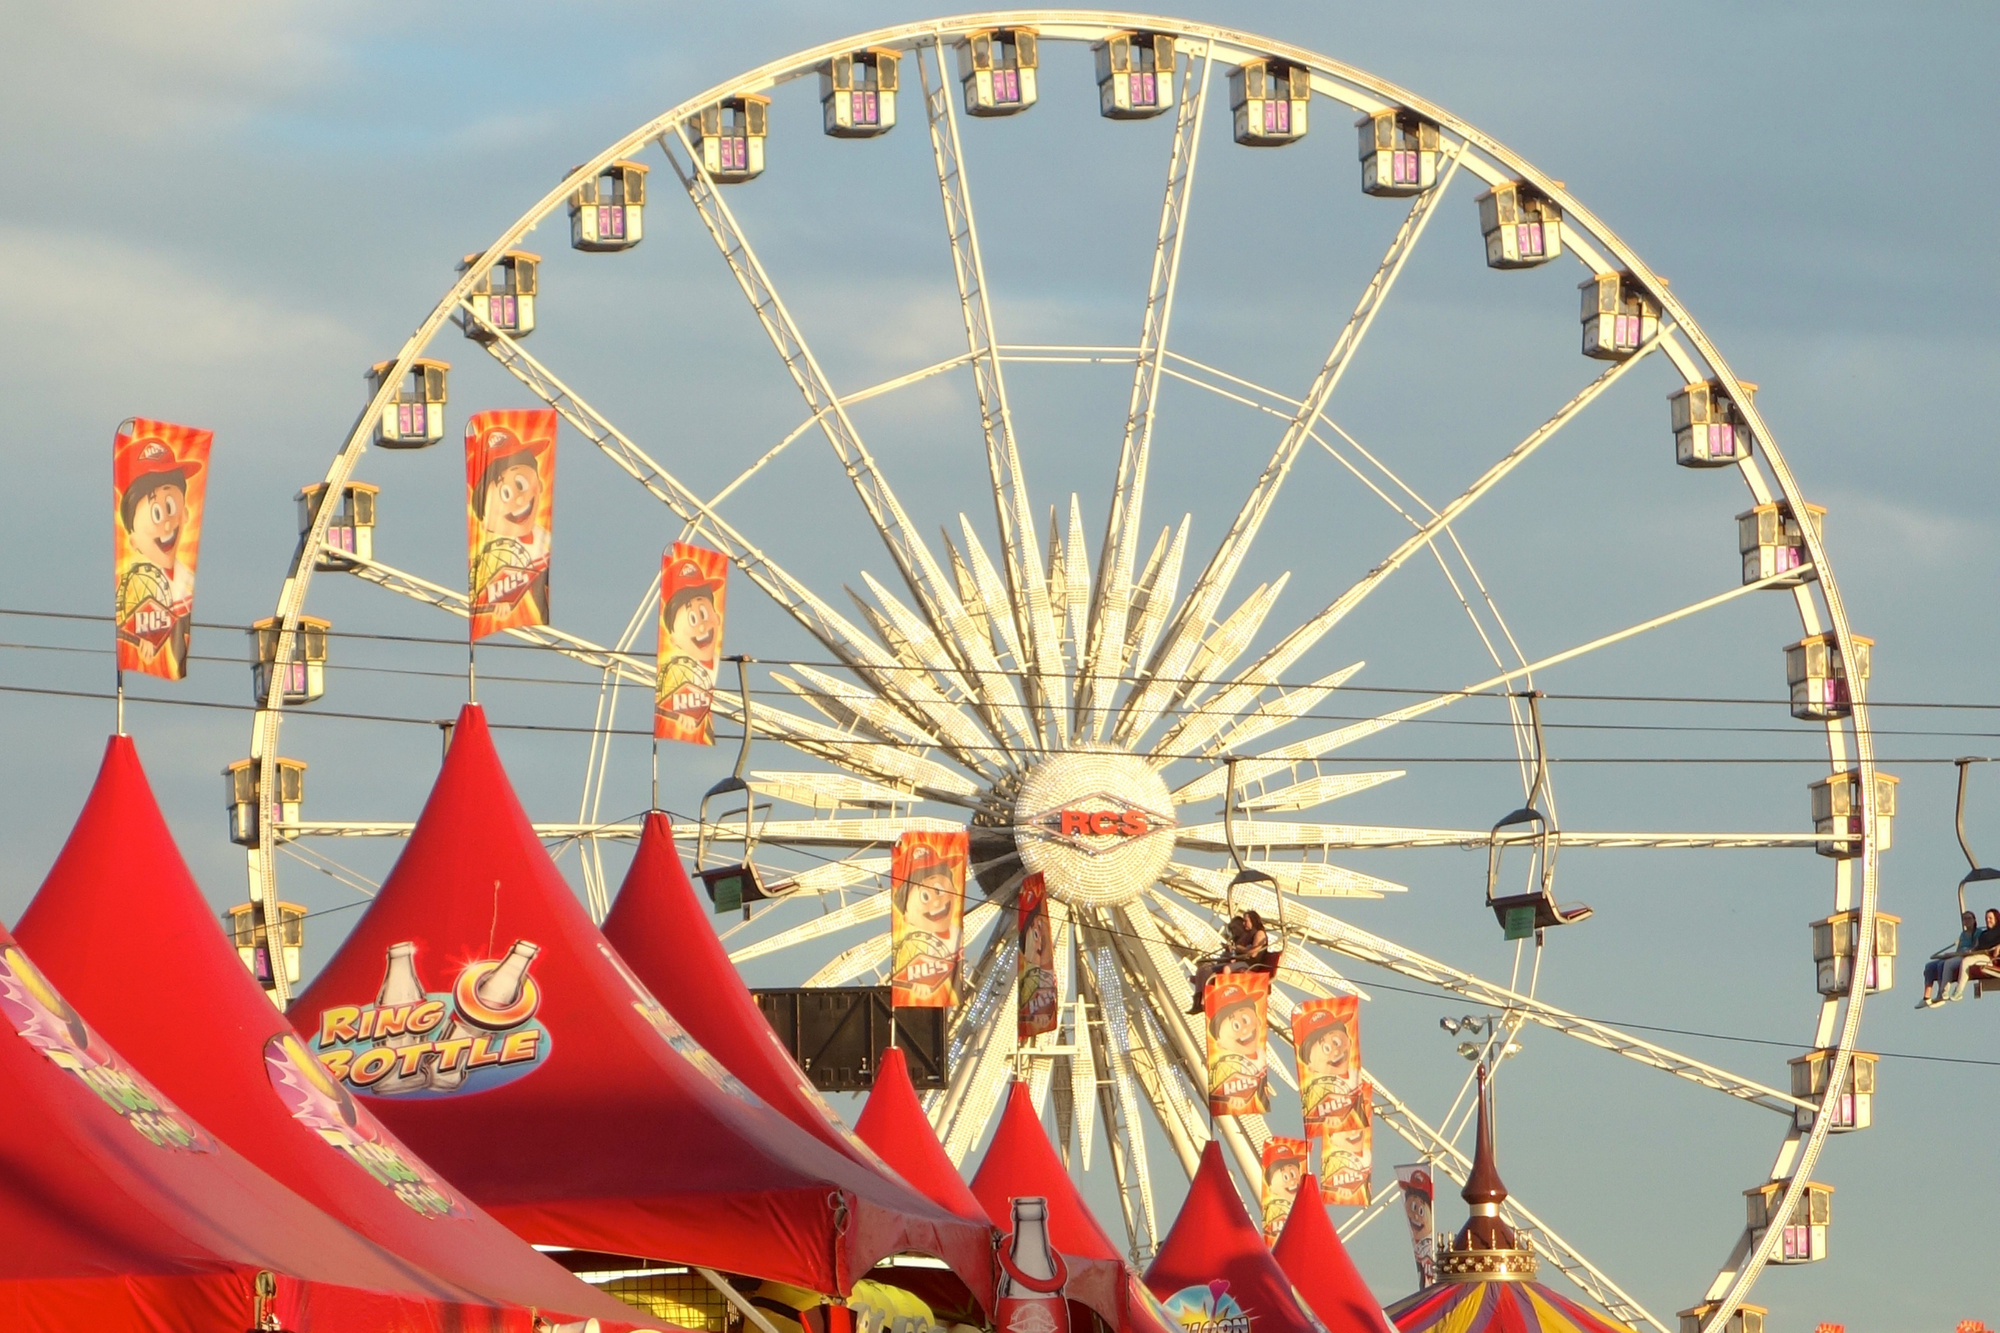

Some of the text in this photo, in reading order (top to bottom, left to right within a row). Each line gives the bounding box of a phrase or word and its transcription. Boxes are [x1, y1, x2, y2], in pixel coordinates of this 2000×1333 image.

[487, 570, 529, 603] RCS
[134, 611, 171, 634] RCS
[673, 692, 710, 711] RCS
[1061, 809, 1147, 835] RCS
[907, 961, 948, 981] RCS
[319, 1000, 445, 1048] RING
[317, 1029, 541, 1087] BOTTLE
[1223, 1078, 1258, 1095] RCS
[1317, 1096, 1352, 1116] RCS
[1333, 1172, 1363, 1186] RCS
